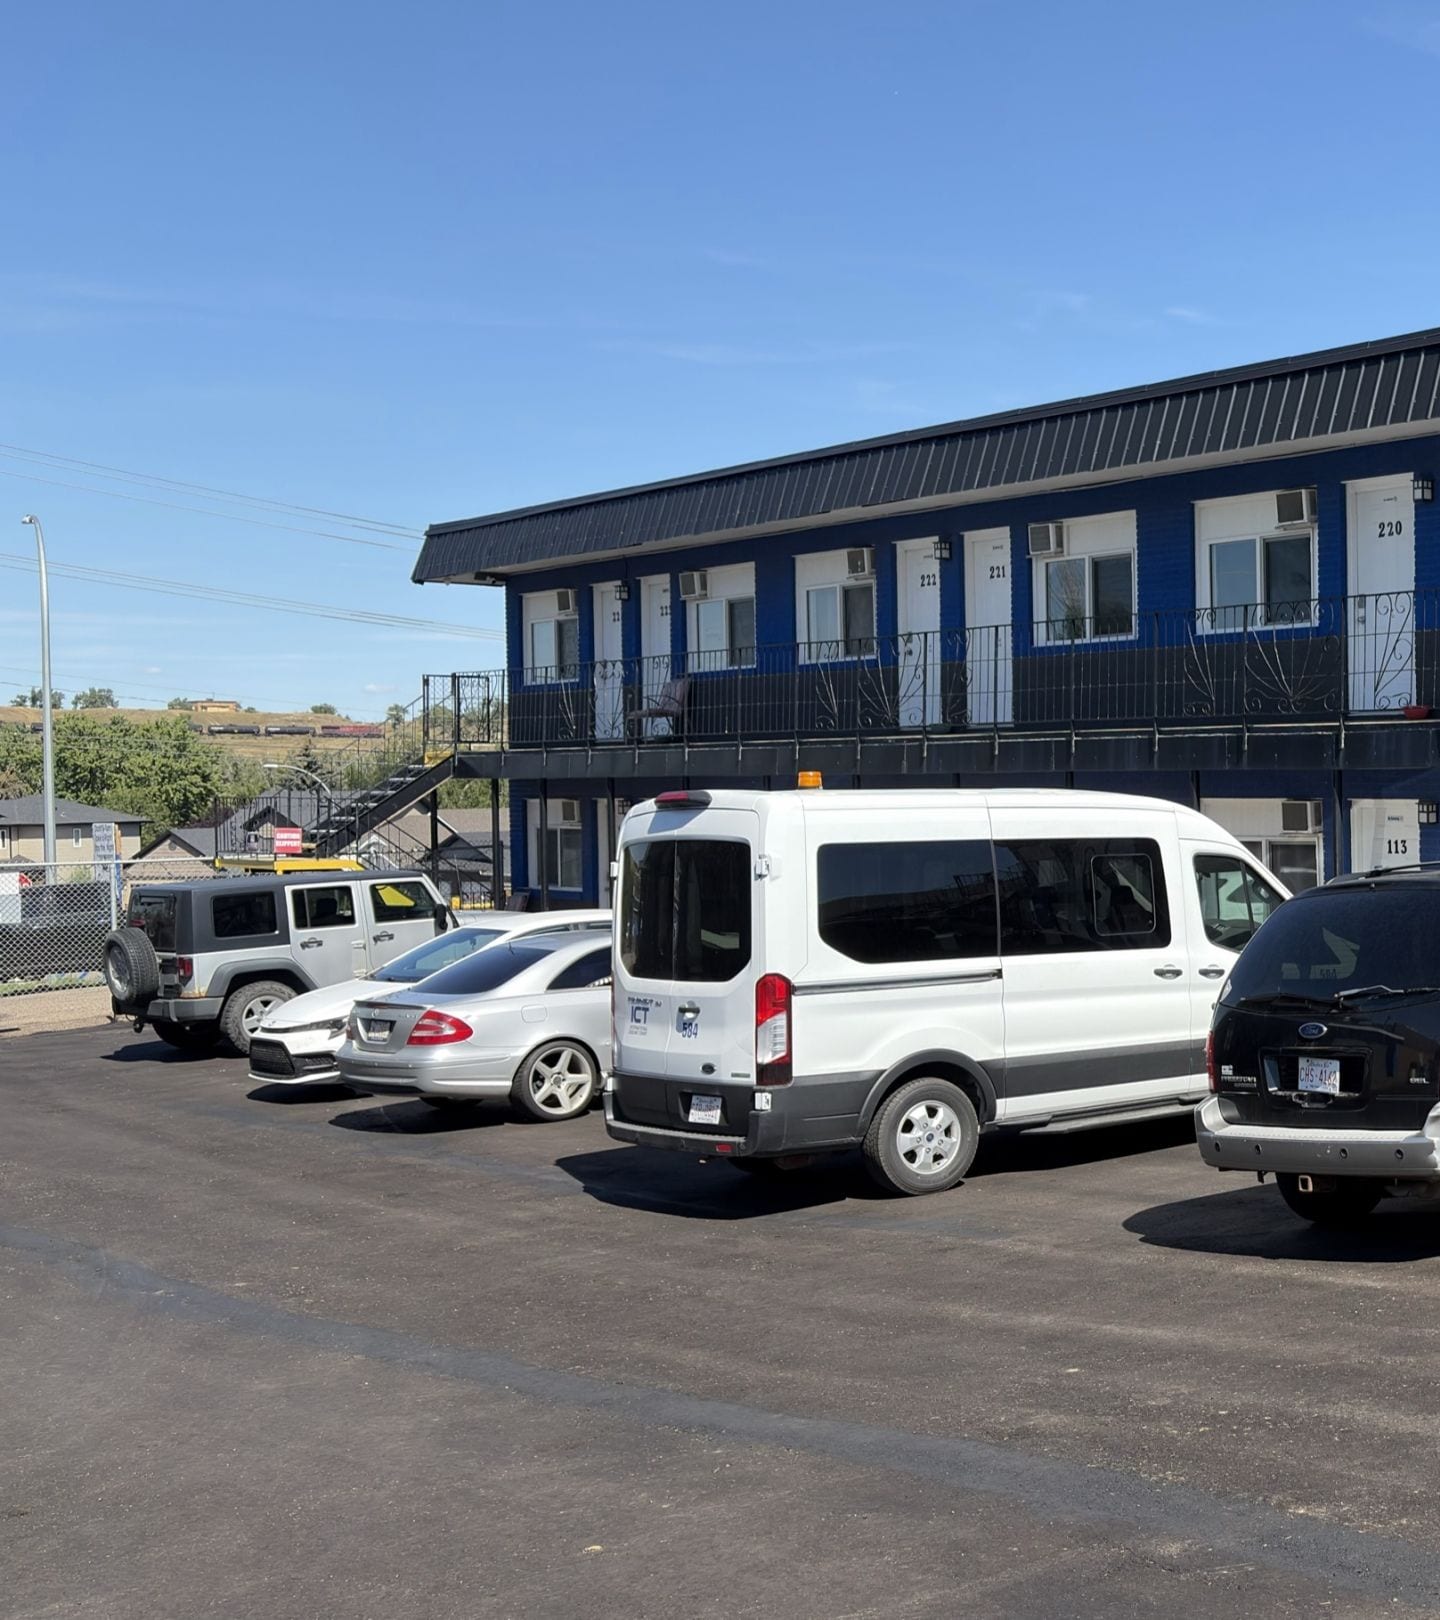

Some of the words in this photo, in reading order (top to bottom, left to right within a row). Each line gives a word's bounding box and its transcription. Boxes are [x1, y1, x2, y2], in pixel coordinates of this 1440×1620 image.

[1378, 520, 1403, 538] 220
[920, 573, 937, 587] 222
[989, 565, 1006, 579] 221
[1387, 839, 1408, 854] 113
[630, 1006, 650, 1024] ICT
[681, 1022, 699, 1039] 584
